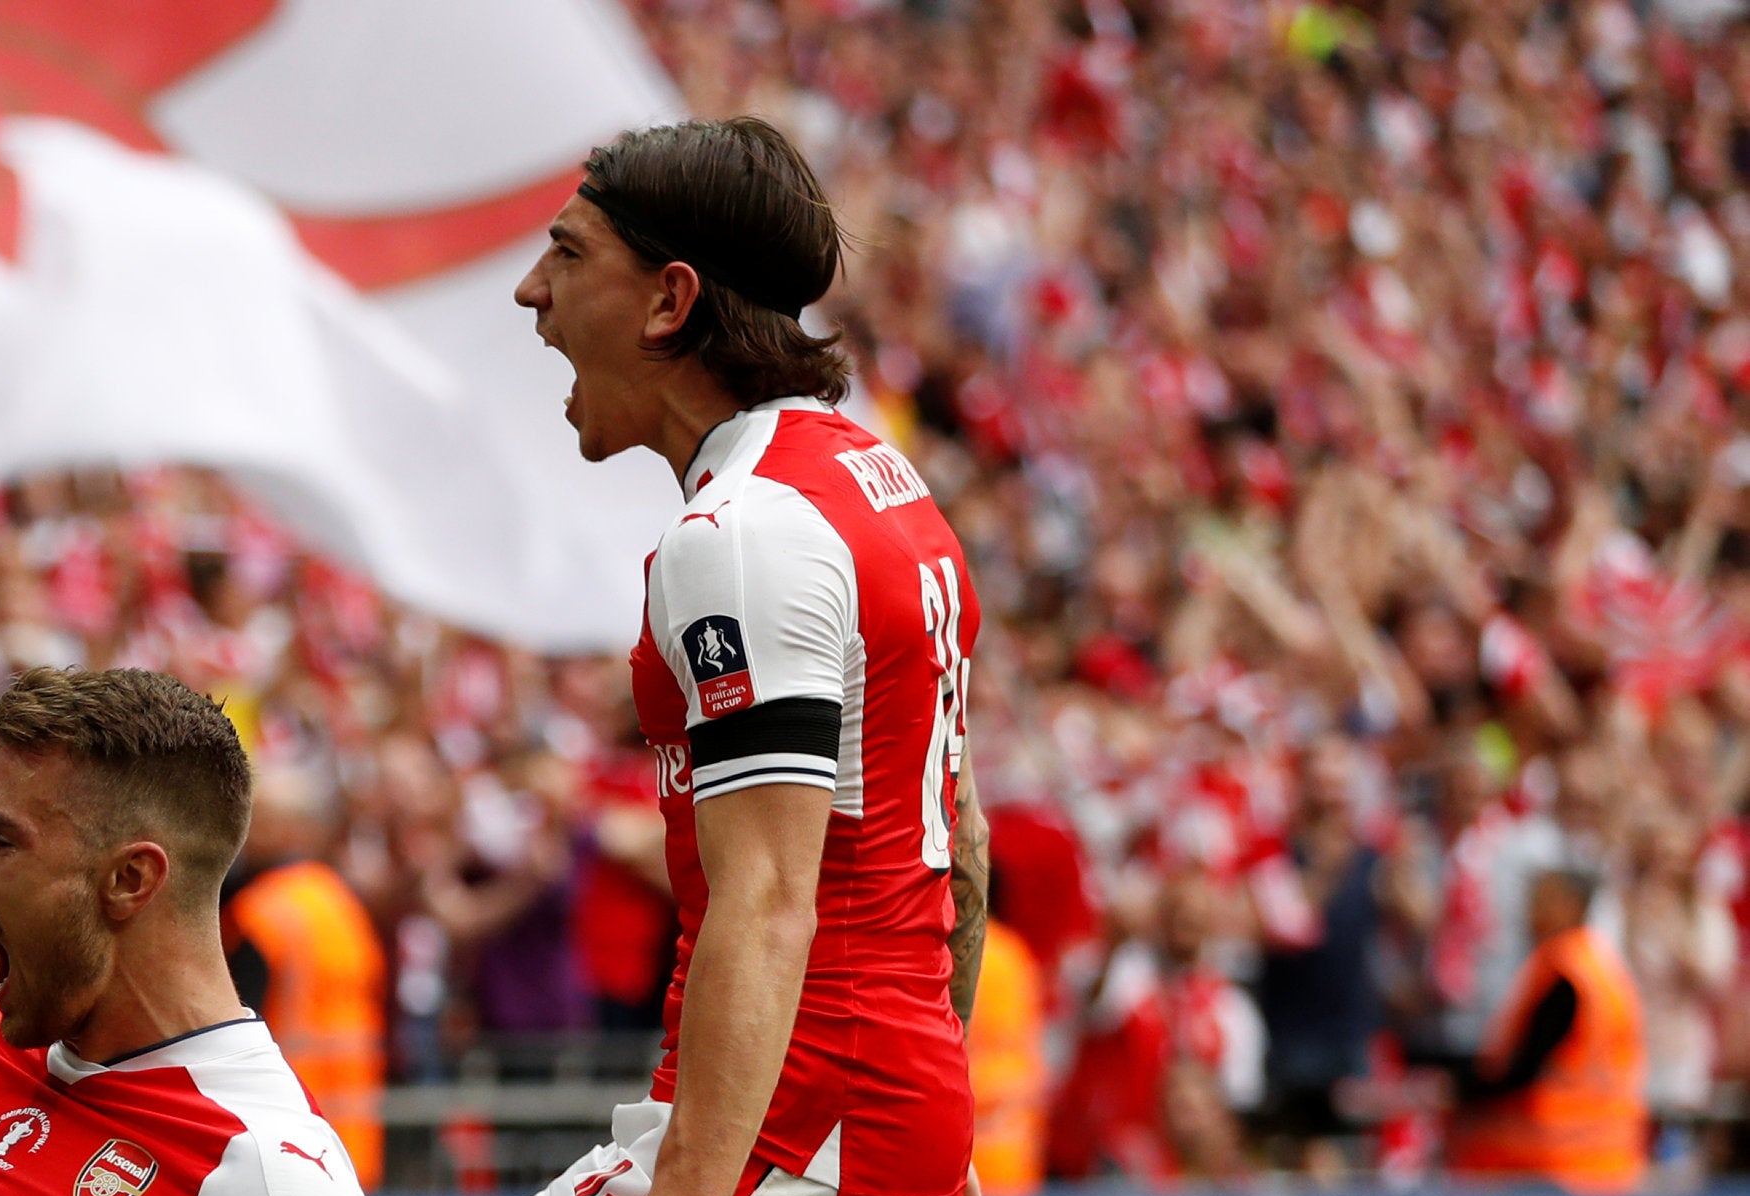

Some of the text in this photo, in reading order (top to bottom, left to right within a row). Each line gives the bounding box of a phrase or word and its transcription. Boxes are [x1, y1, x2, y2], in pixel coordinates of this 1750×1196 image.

[716, 681, 728, 689] THE
[705, 685, 747, 703] Emirates
[712, 696, 742, 712] FA CUP
[102, 1150, 149, 1180] Arsenal
